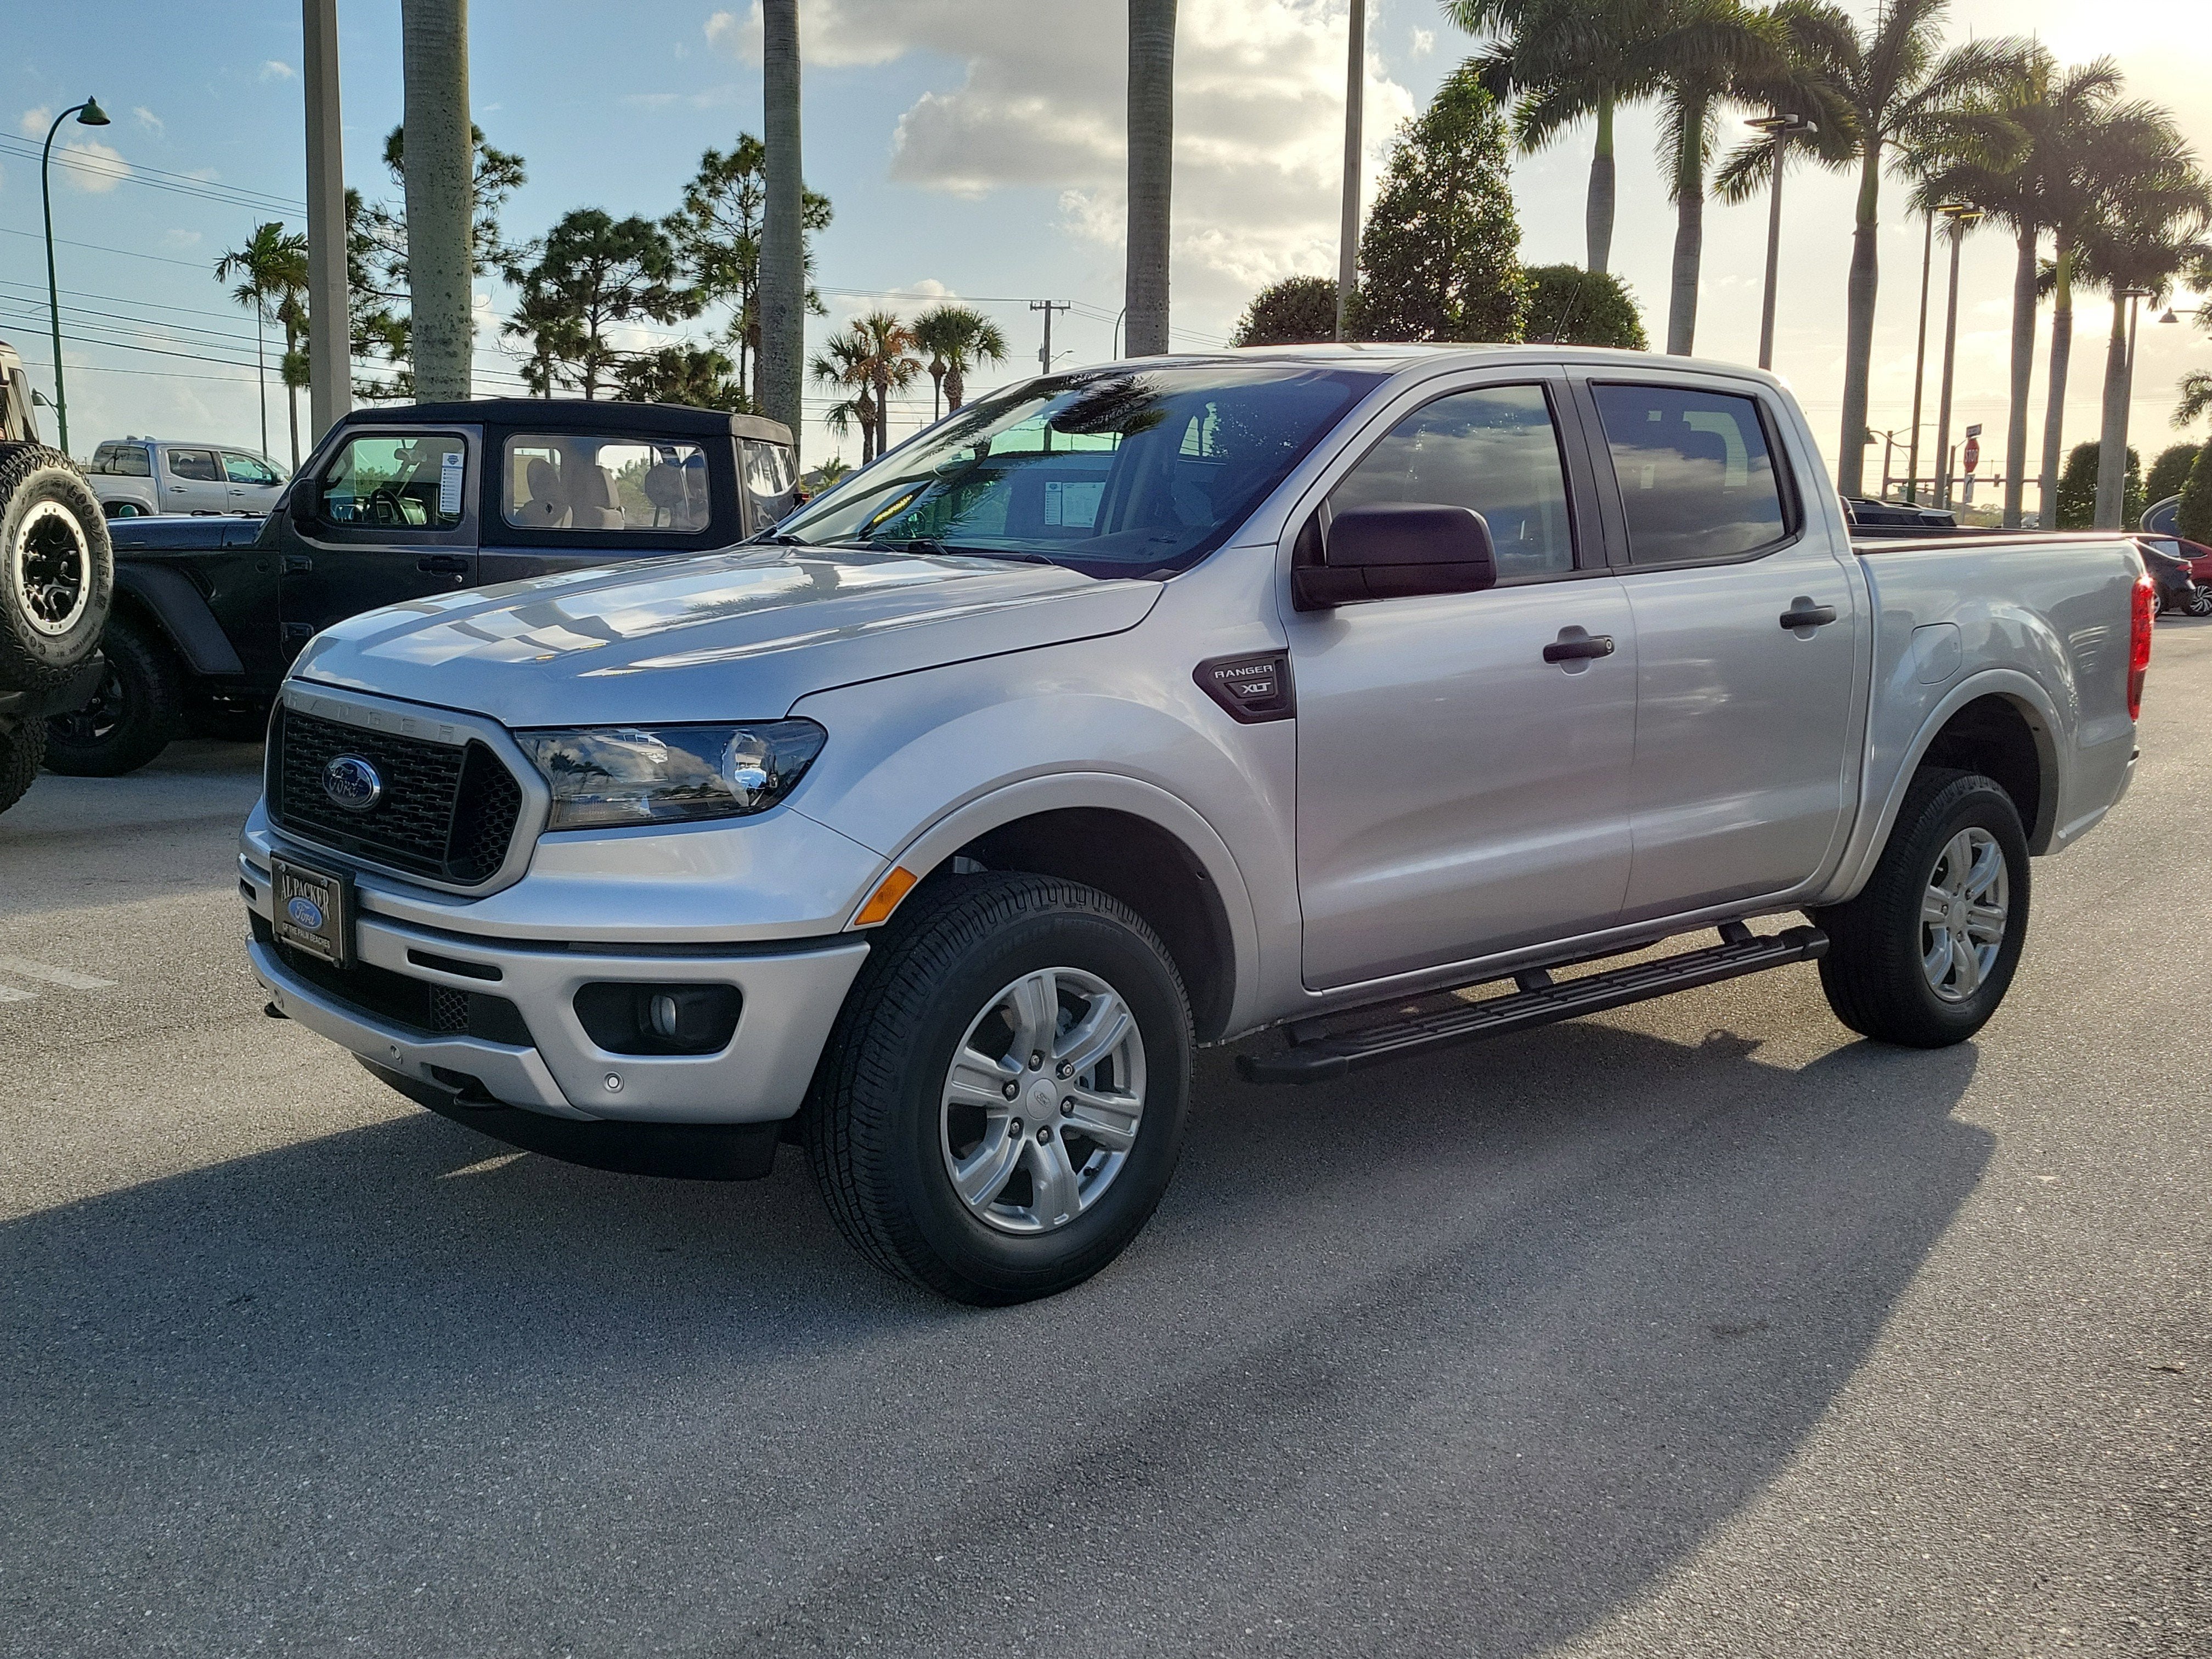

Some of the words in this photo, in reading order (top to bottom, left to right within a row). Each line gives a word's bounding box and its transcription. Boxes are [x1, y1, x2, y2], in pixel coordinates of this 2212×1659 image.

[1965, 449, 1978, 462] STOP
[1214, 664, 1273, 679] RANGER
[1240, 681, 1272, 694] XLT
[329, 764, 360, 798] Ford
[281, 874, 294, 901] AL
[294, 877, 330, 921] PACKER
[295, 901, 318, 926] Ford
[288, 925, 298, 935] THE
[297, 928, 310, 939] PALM
[309, 933, 330, 949] BEACHES
